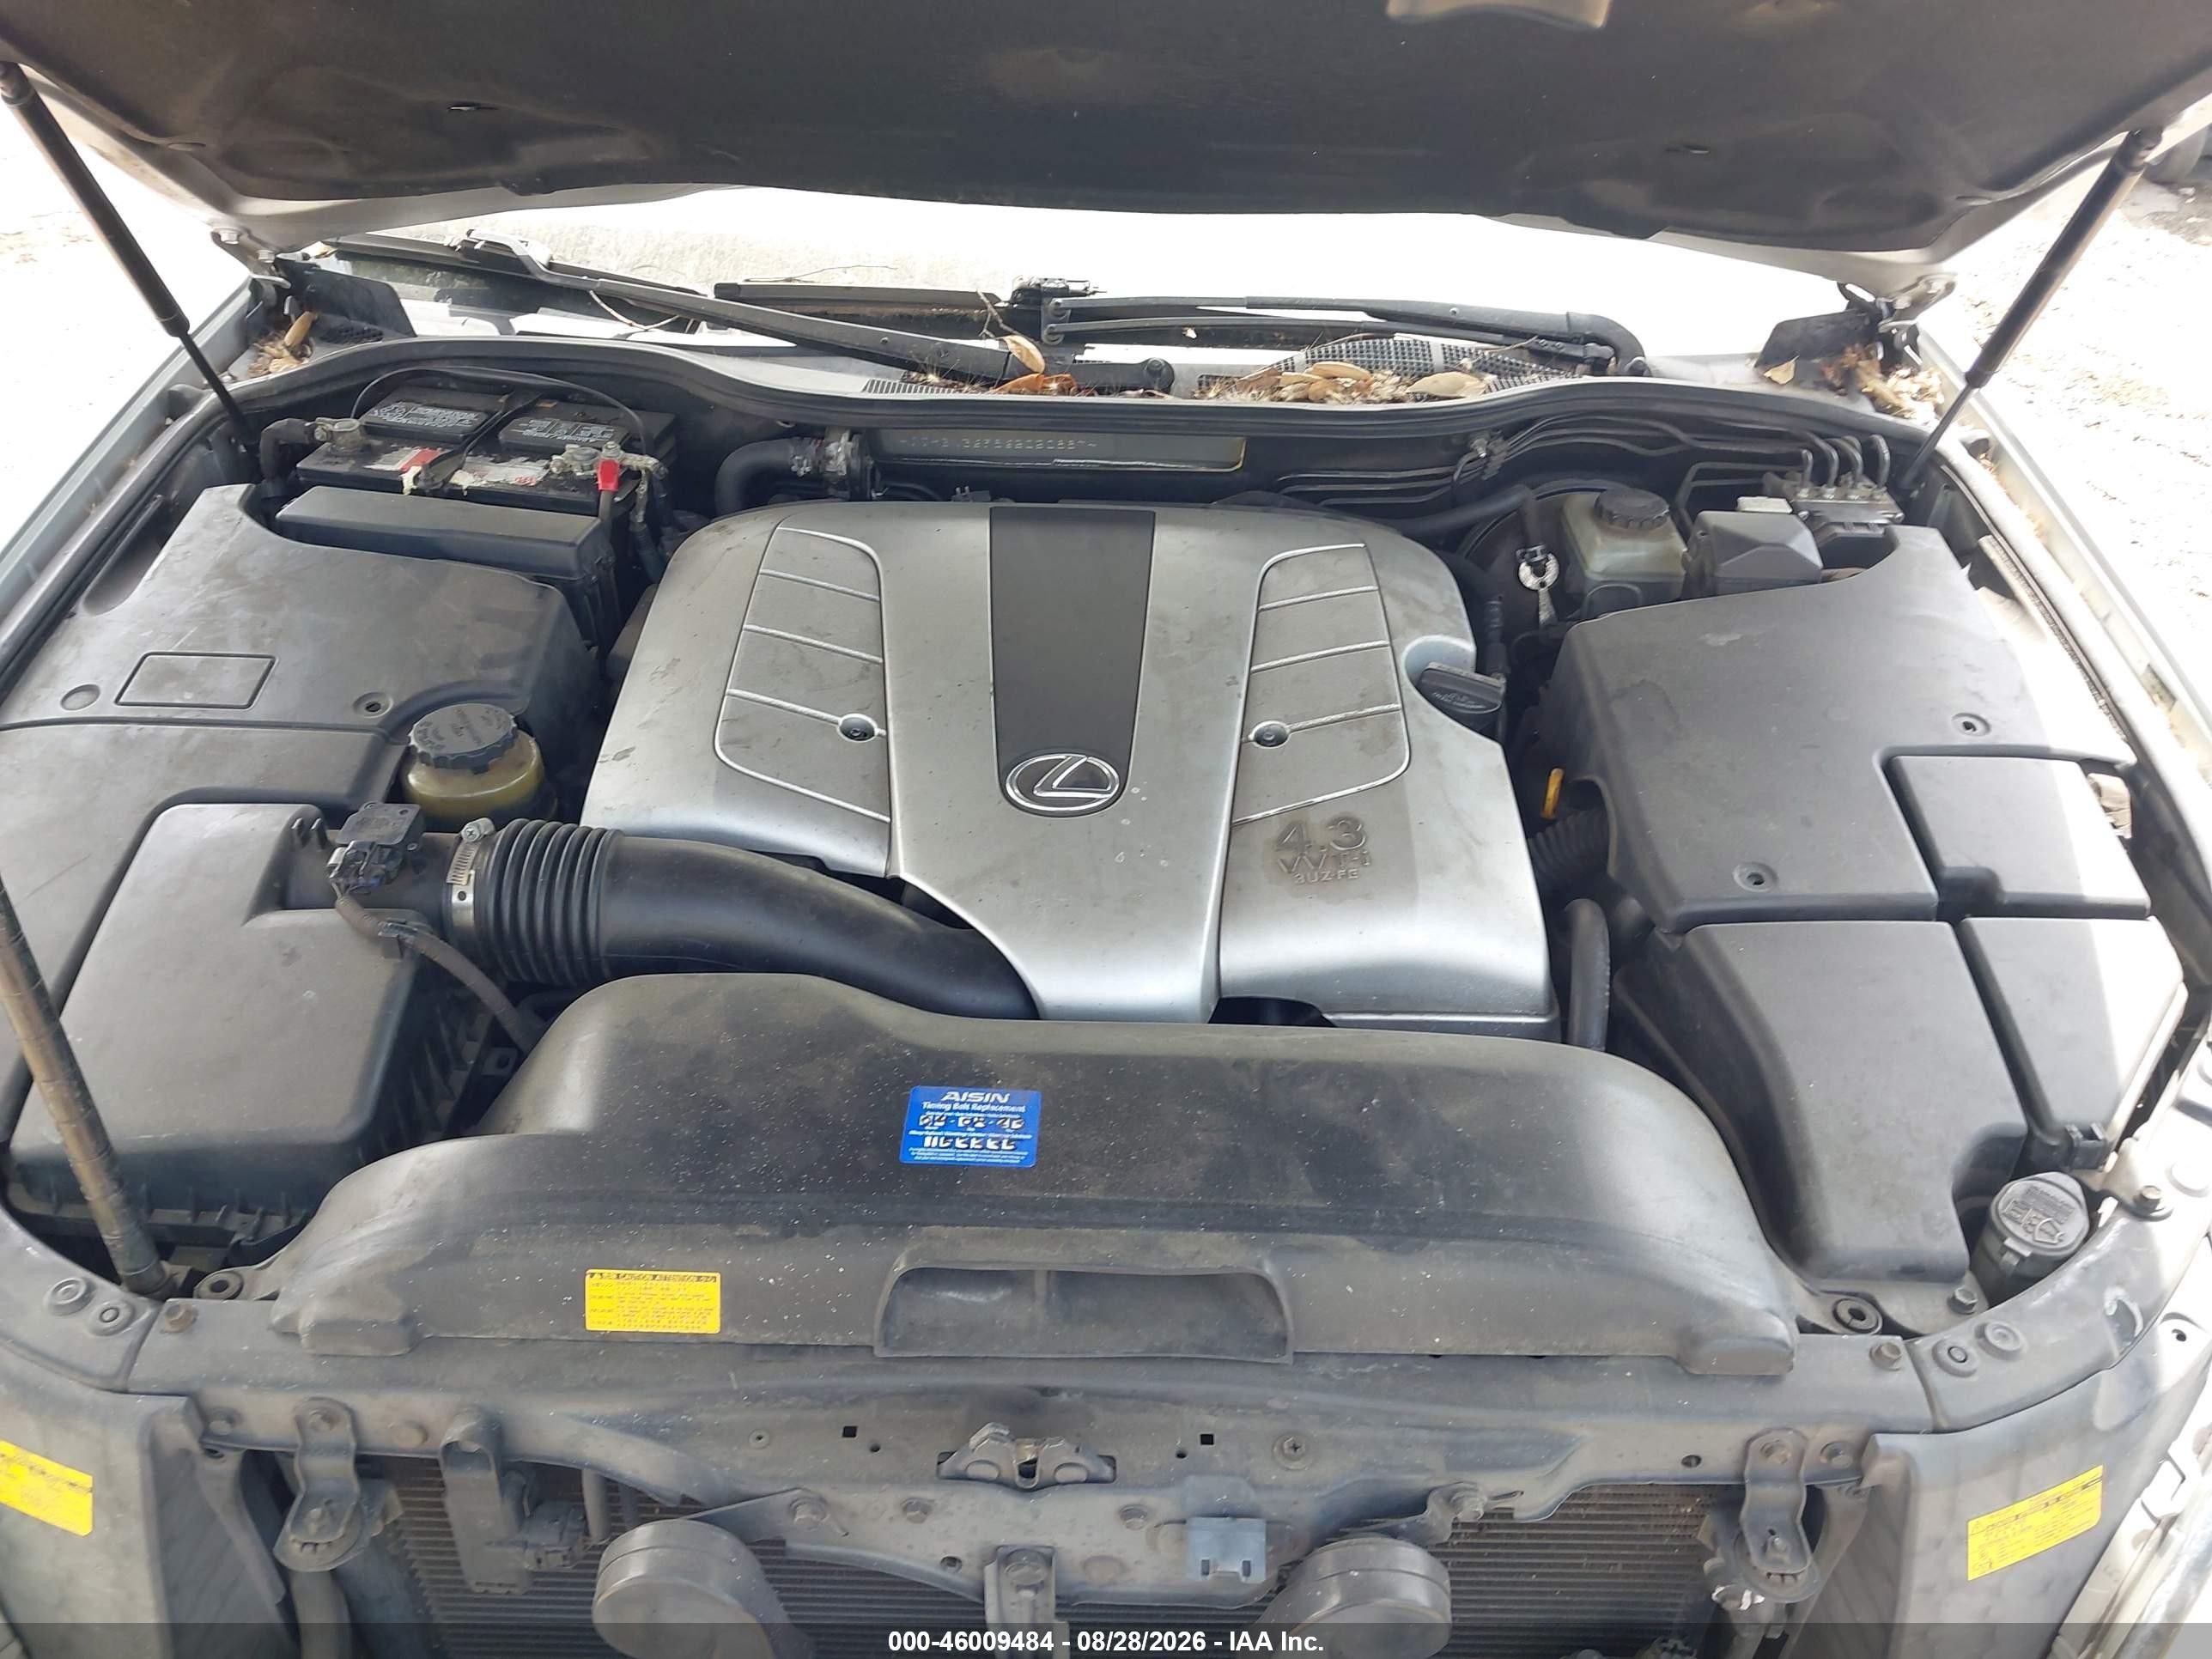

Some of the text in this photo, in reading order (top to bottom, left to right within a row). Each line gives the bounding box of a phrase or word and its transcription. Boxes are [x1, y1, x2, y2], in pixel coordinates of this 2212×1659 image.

[1275, 816, 1369, 854] 4.3
[1293, 868, 1360, 885] 3UZ-FE
[941, 1091, 1011, 1103] AISIN
[921, 1101, 1026, 1113] Timing Belt Replacement
